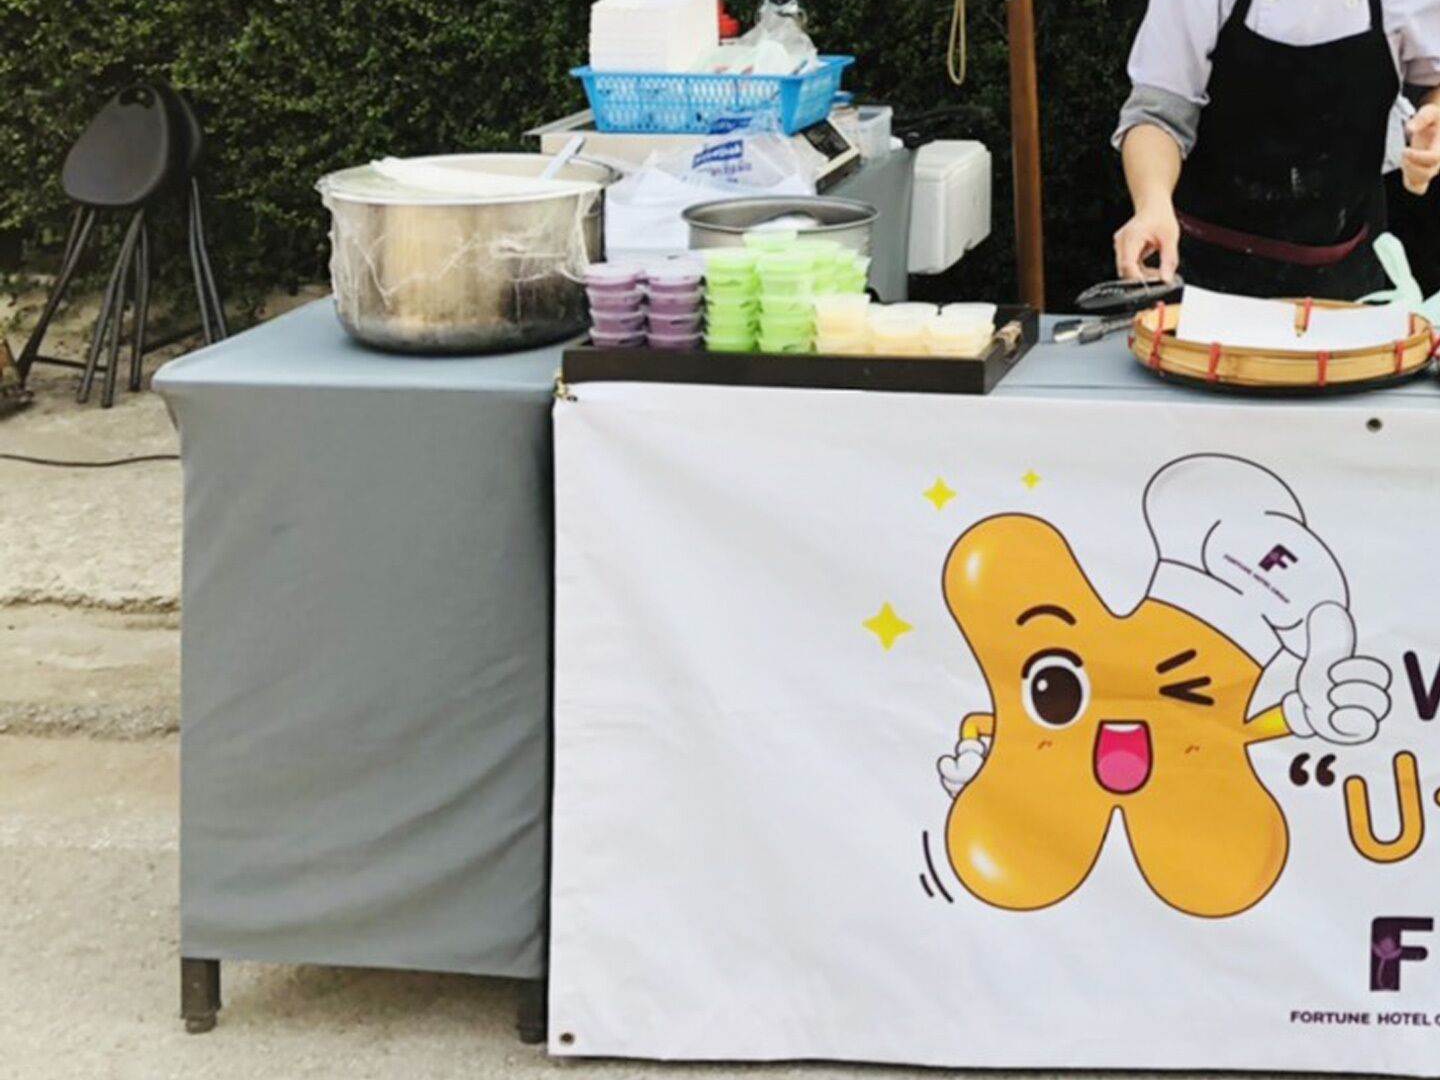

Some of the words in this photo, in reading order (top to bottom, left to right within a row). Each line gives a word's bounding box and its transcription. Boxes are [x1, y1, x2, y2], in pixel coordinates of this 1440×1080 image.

[1369, 916, 1434, 992] F
[1290, 1010, 1371, 1025] FORTUNE
[1376, 1012, 1431, 1027] HOTEL
